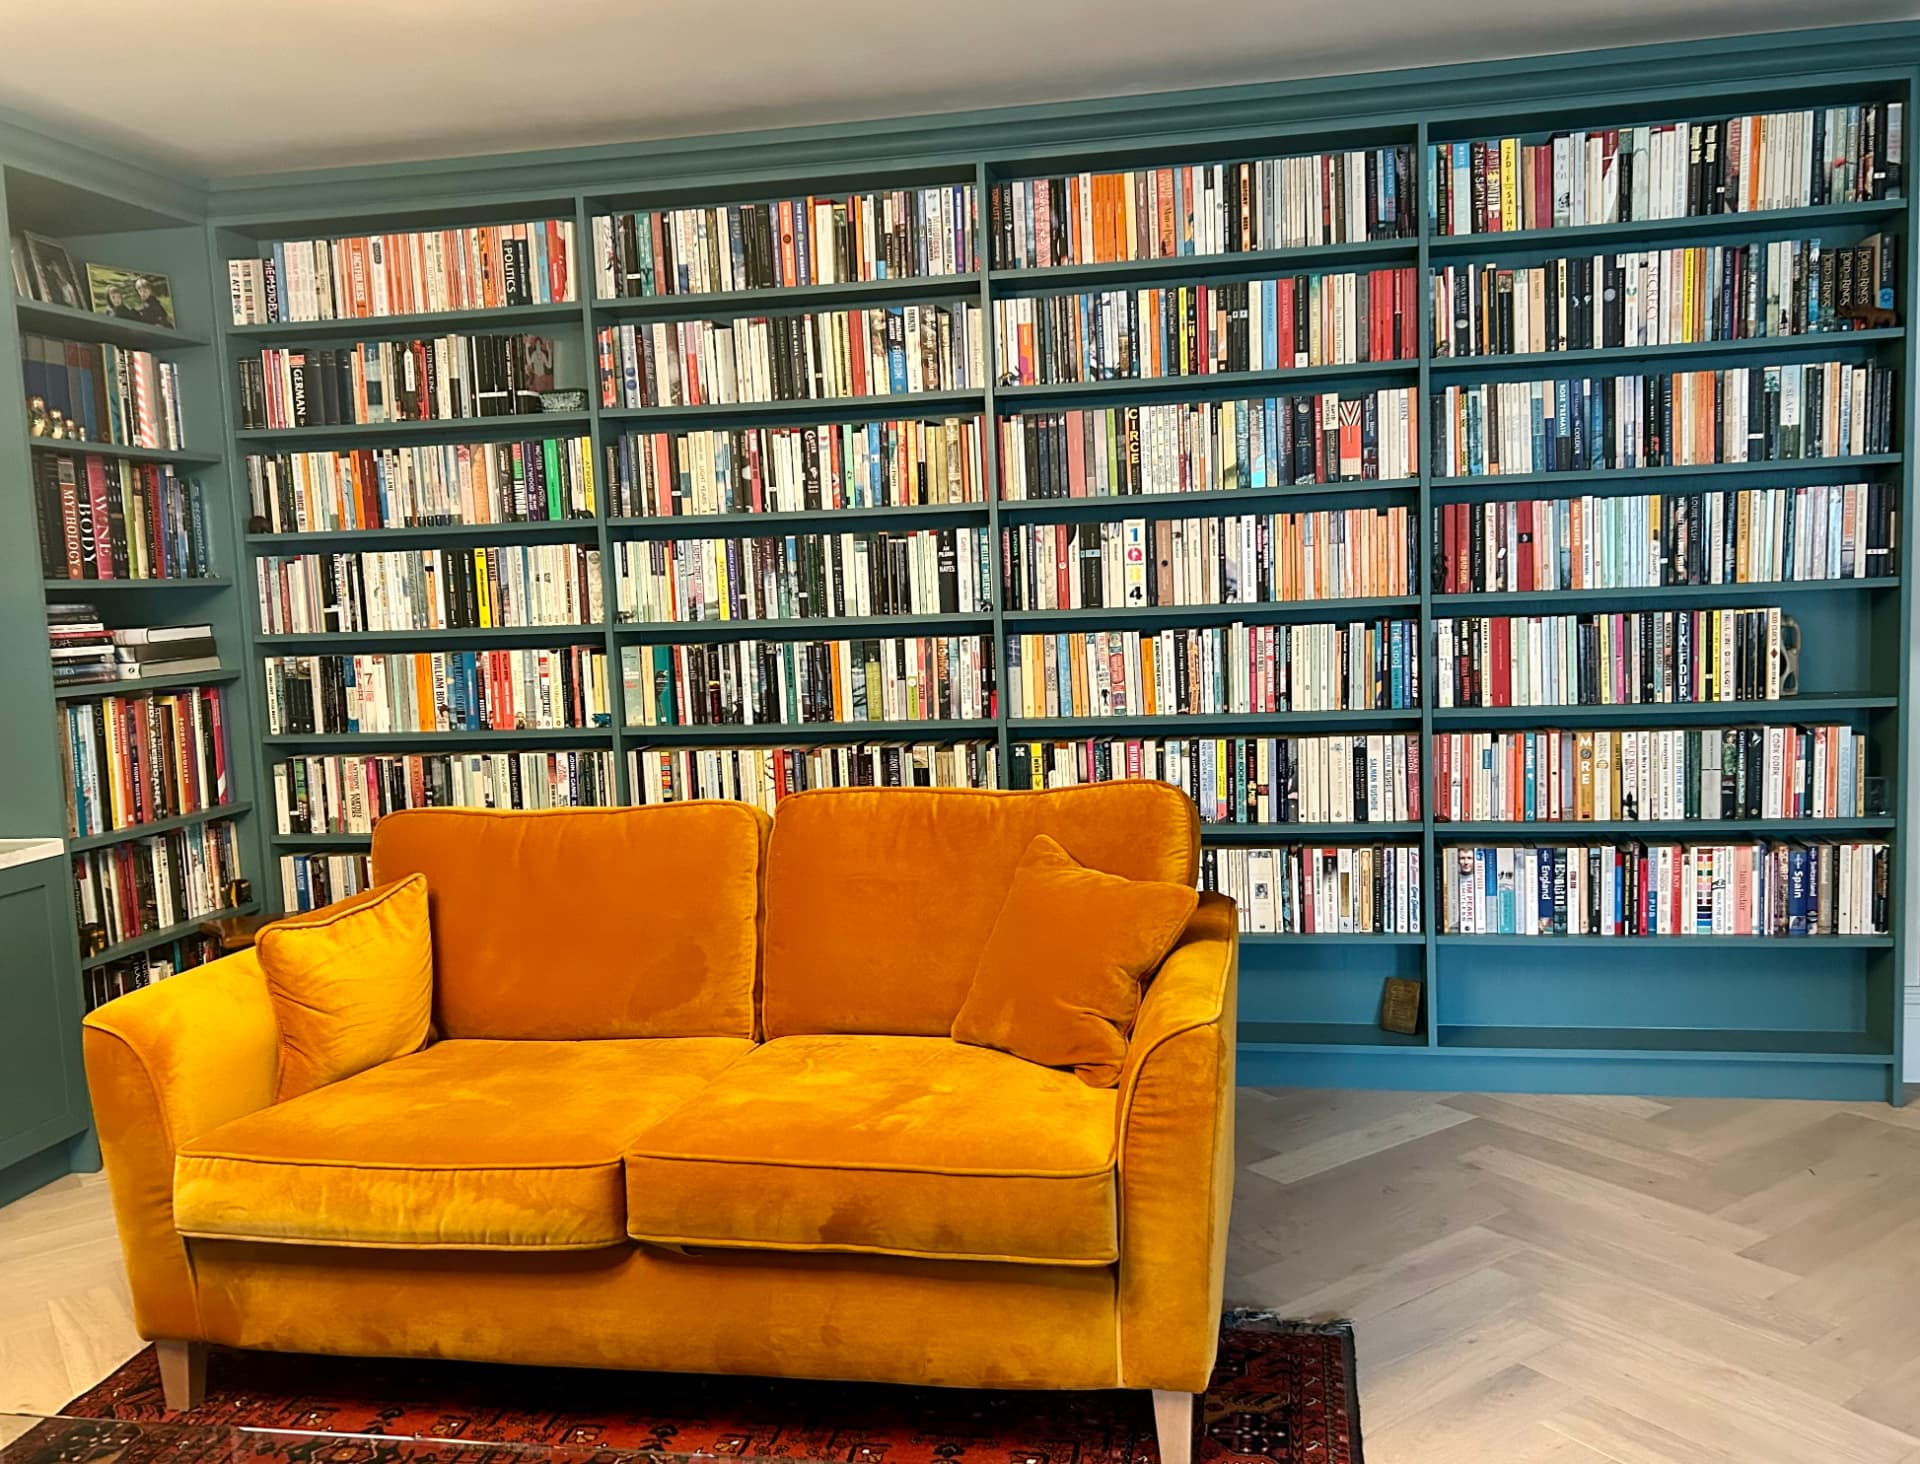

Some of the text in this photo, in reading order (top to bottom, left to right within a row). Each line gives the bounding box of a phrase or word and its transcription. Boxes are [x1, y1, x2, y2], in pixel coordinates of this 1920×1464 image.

[1474, 147, 1485, 208] ZADIE SMITH
[504, 248, 515, 292] POLITICS
[1648, 267, 1658, 320] SECRECY
[908, 309, 917, 332] FRANZEN
[893, 345, 903, 379] FREEDOM
[294, 369, 305, 415] GERMAN
[1129, 409, 1139, 463] CIRCE
[1559, 404, 1568, 435] TREMAIN
[63, 489, 80, 566] MYTHOLOGY
[78, 502, 95, 565] BODY
[194, 501, 205, 560] economics
[434, 656, 445, 689] WILLIAM
[1526, 740, 1534, 768] mindset
[1772, 733, 1780, 776] CORK DORK
[1540, 865, 1550, 900] England
[1792, 871, 1803, 898] Spain
